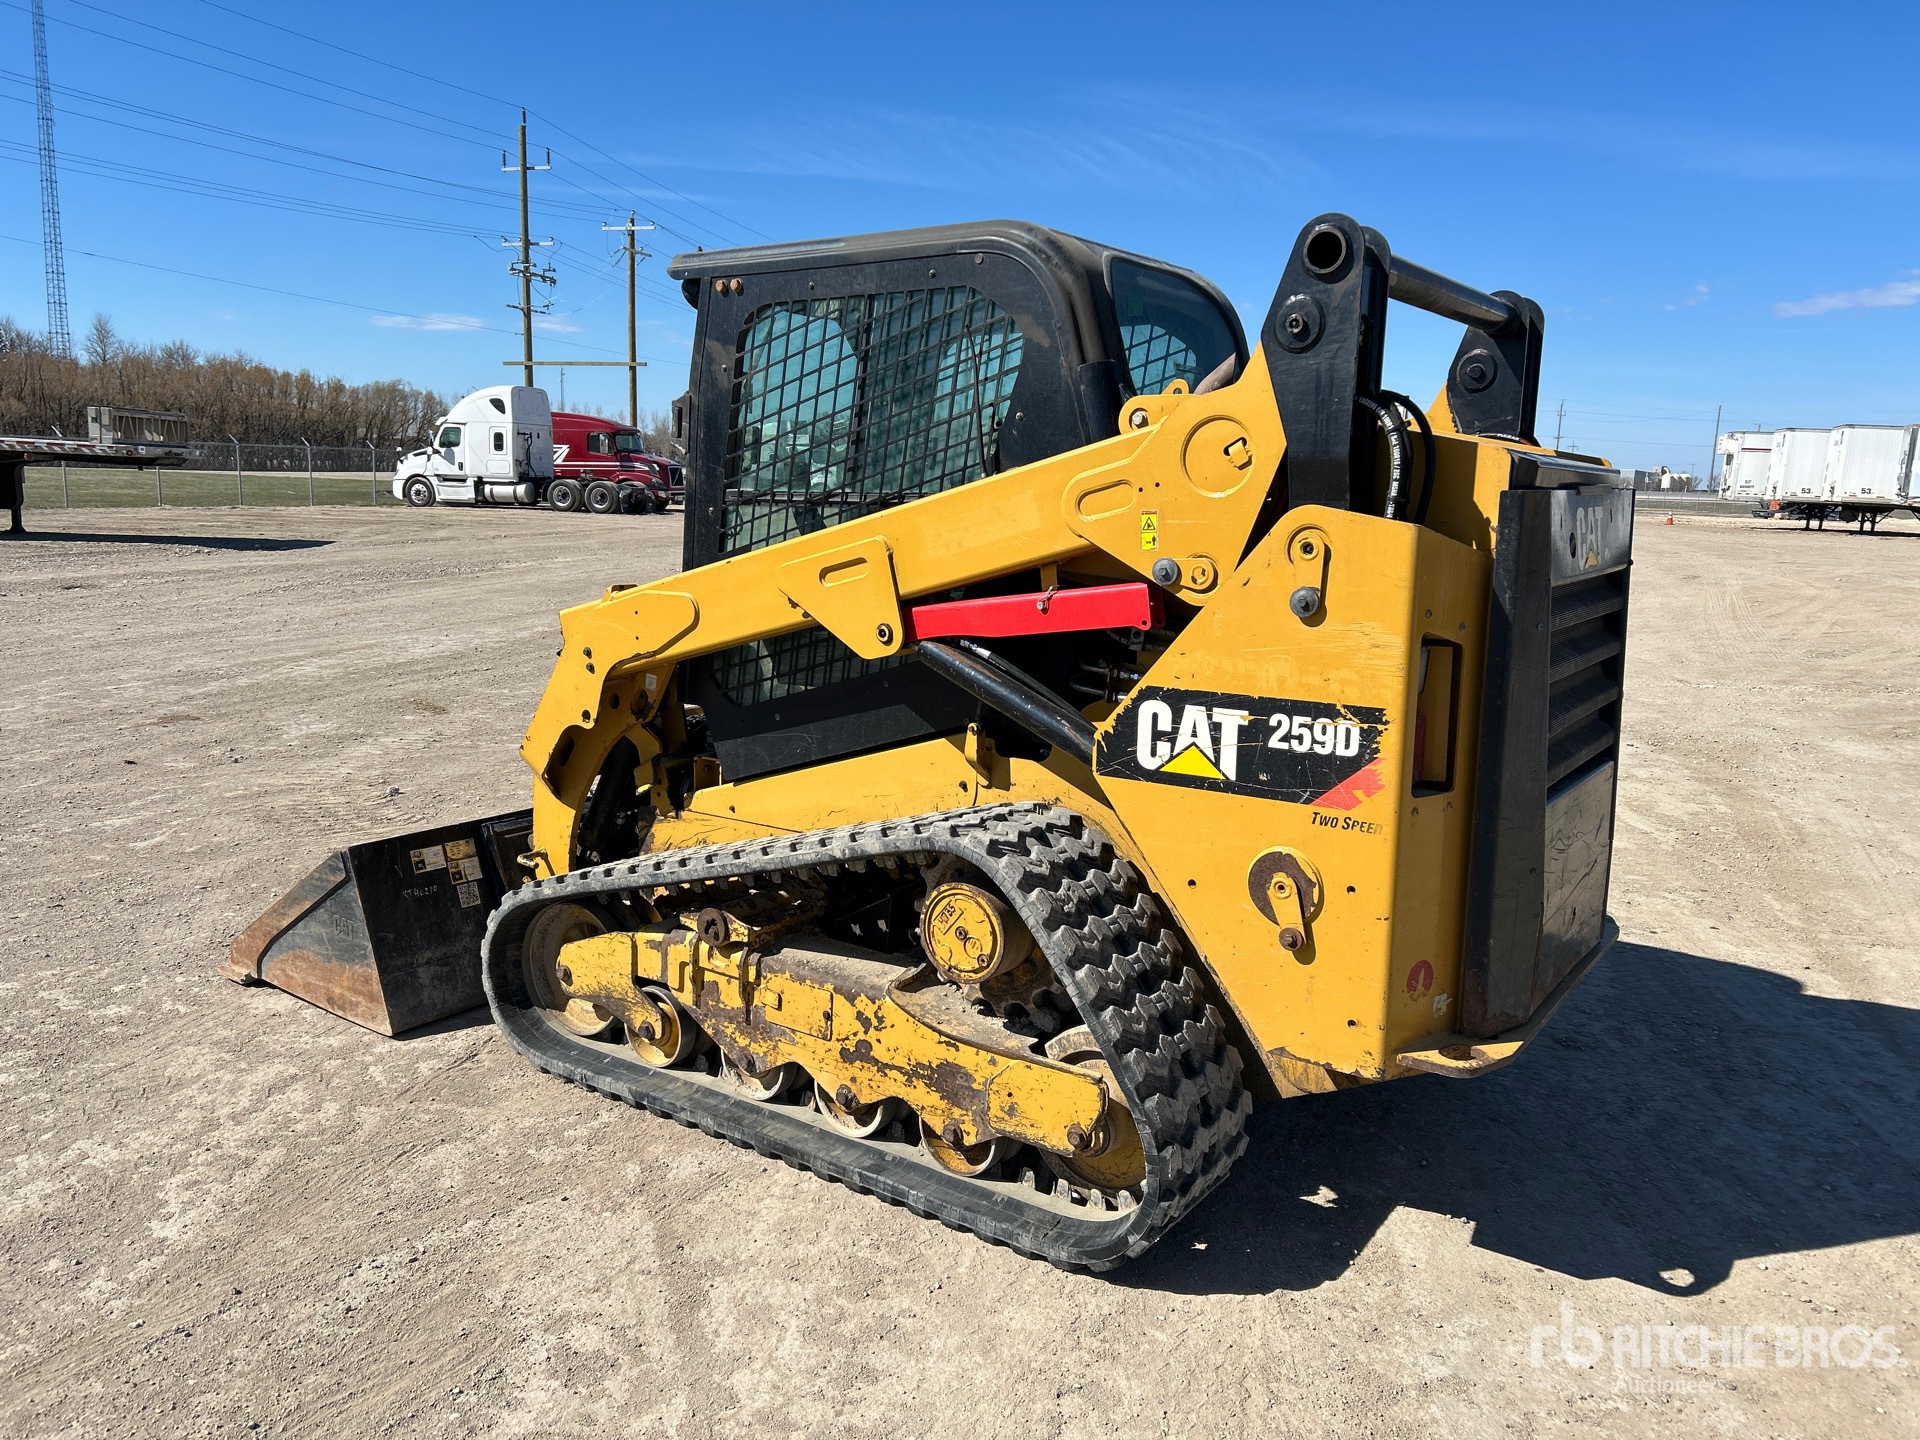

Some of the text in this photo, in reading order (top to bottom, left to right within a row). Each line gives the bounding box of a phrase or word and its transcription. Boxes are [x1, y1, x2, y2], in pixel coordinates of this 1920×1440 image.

[1801, 487, 1811, 495] 53
[1860, 487, 1872, 495] 53
[1576, 506, 1603, 571] CAT
[1136, 699, 1360, 781] CAT 259D
